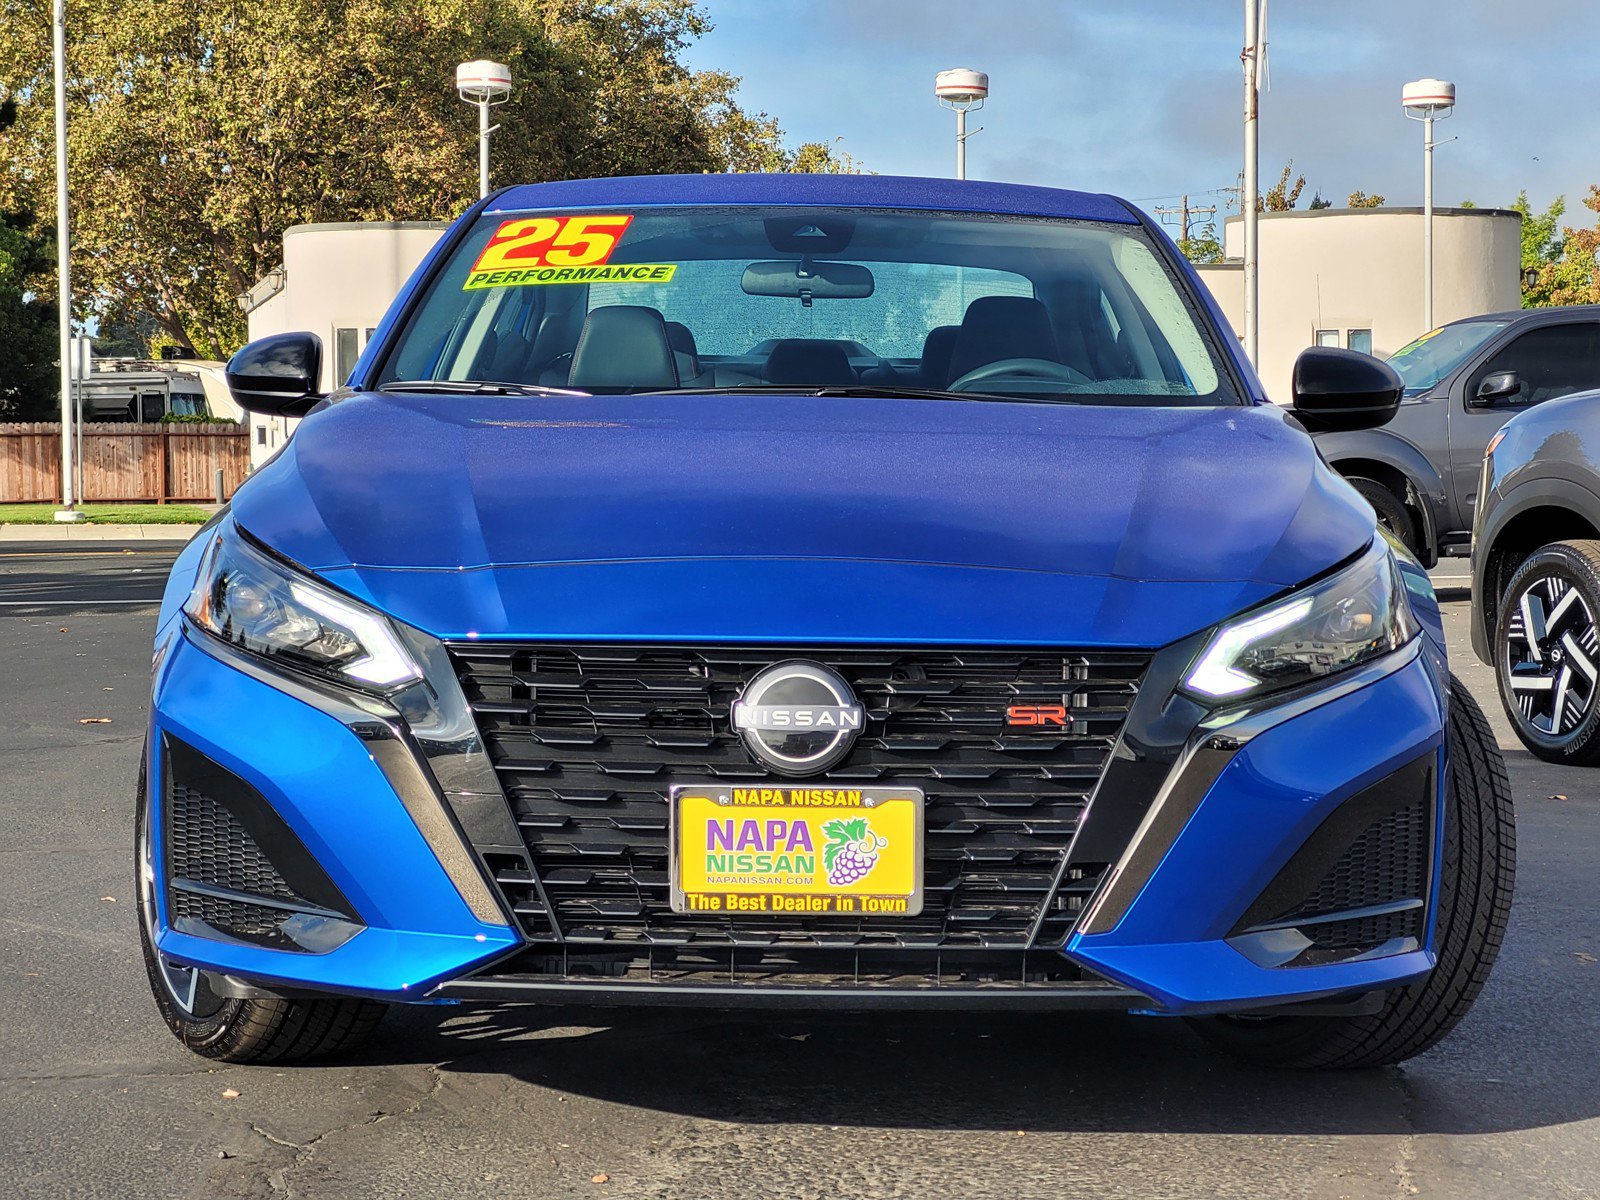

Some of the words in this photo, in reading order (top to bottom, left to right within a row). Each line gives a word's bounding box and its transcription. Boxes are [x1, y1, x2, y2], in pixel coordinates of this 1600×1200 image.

[475, 216, 629, 271] 25
[469, 266, 669, 286] PERFORMANCE
[740, 710, 859, 726] NISSAN
[1007, 705, 1067, 725] SR
[733, 789, 785, 806] NAPA
[792, 790, 861, 806] NISSAN
[707, 819, 813, 852] NAPA
[707, 855, 814, 873] NISSAN
[707, 876, 814, 885] NAPANISSAN.COM
[688, 894, 720, 910] The
[726, 894, 767, 911] Best
[773, 895, 831, 911] Dealer
[860, 896, 906, 912] Town
